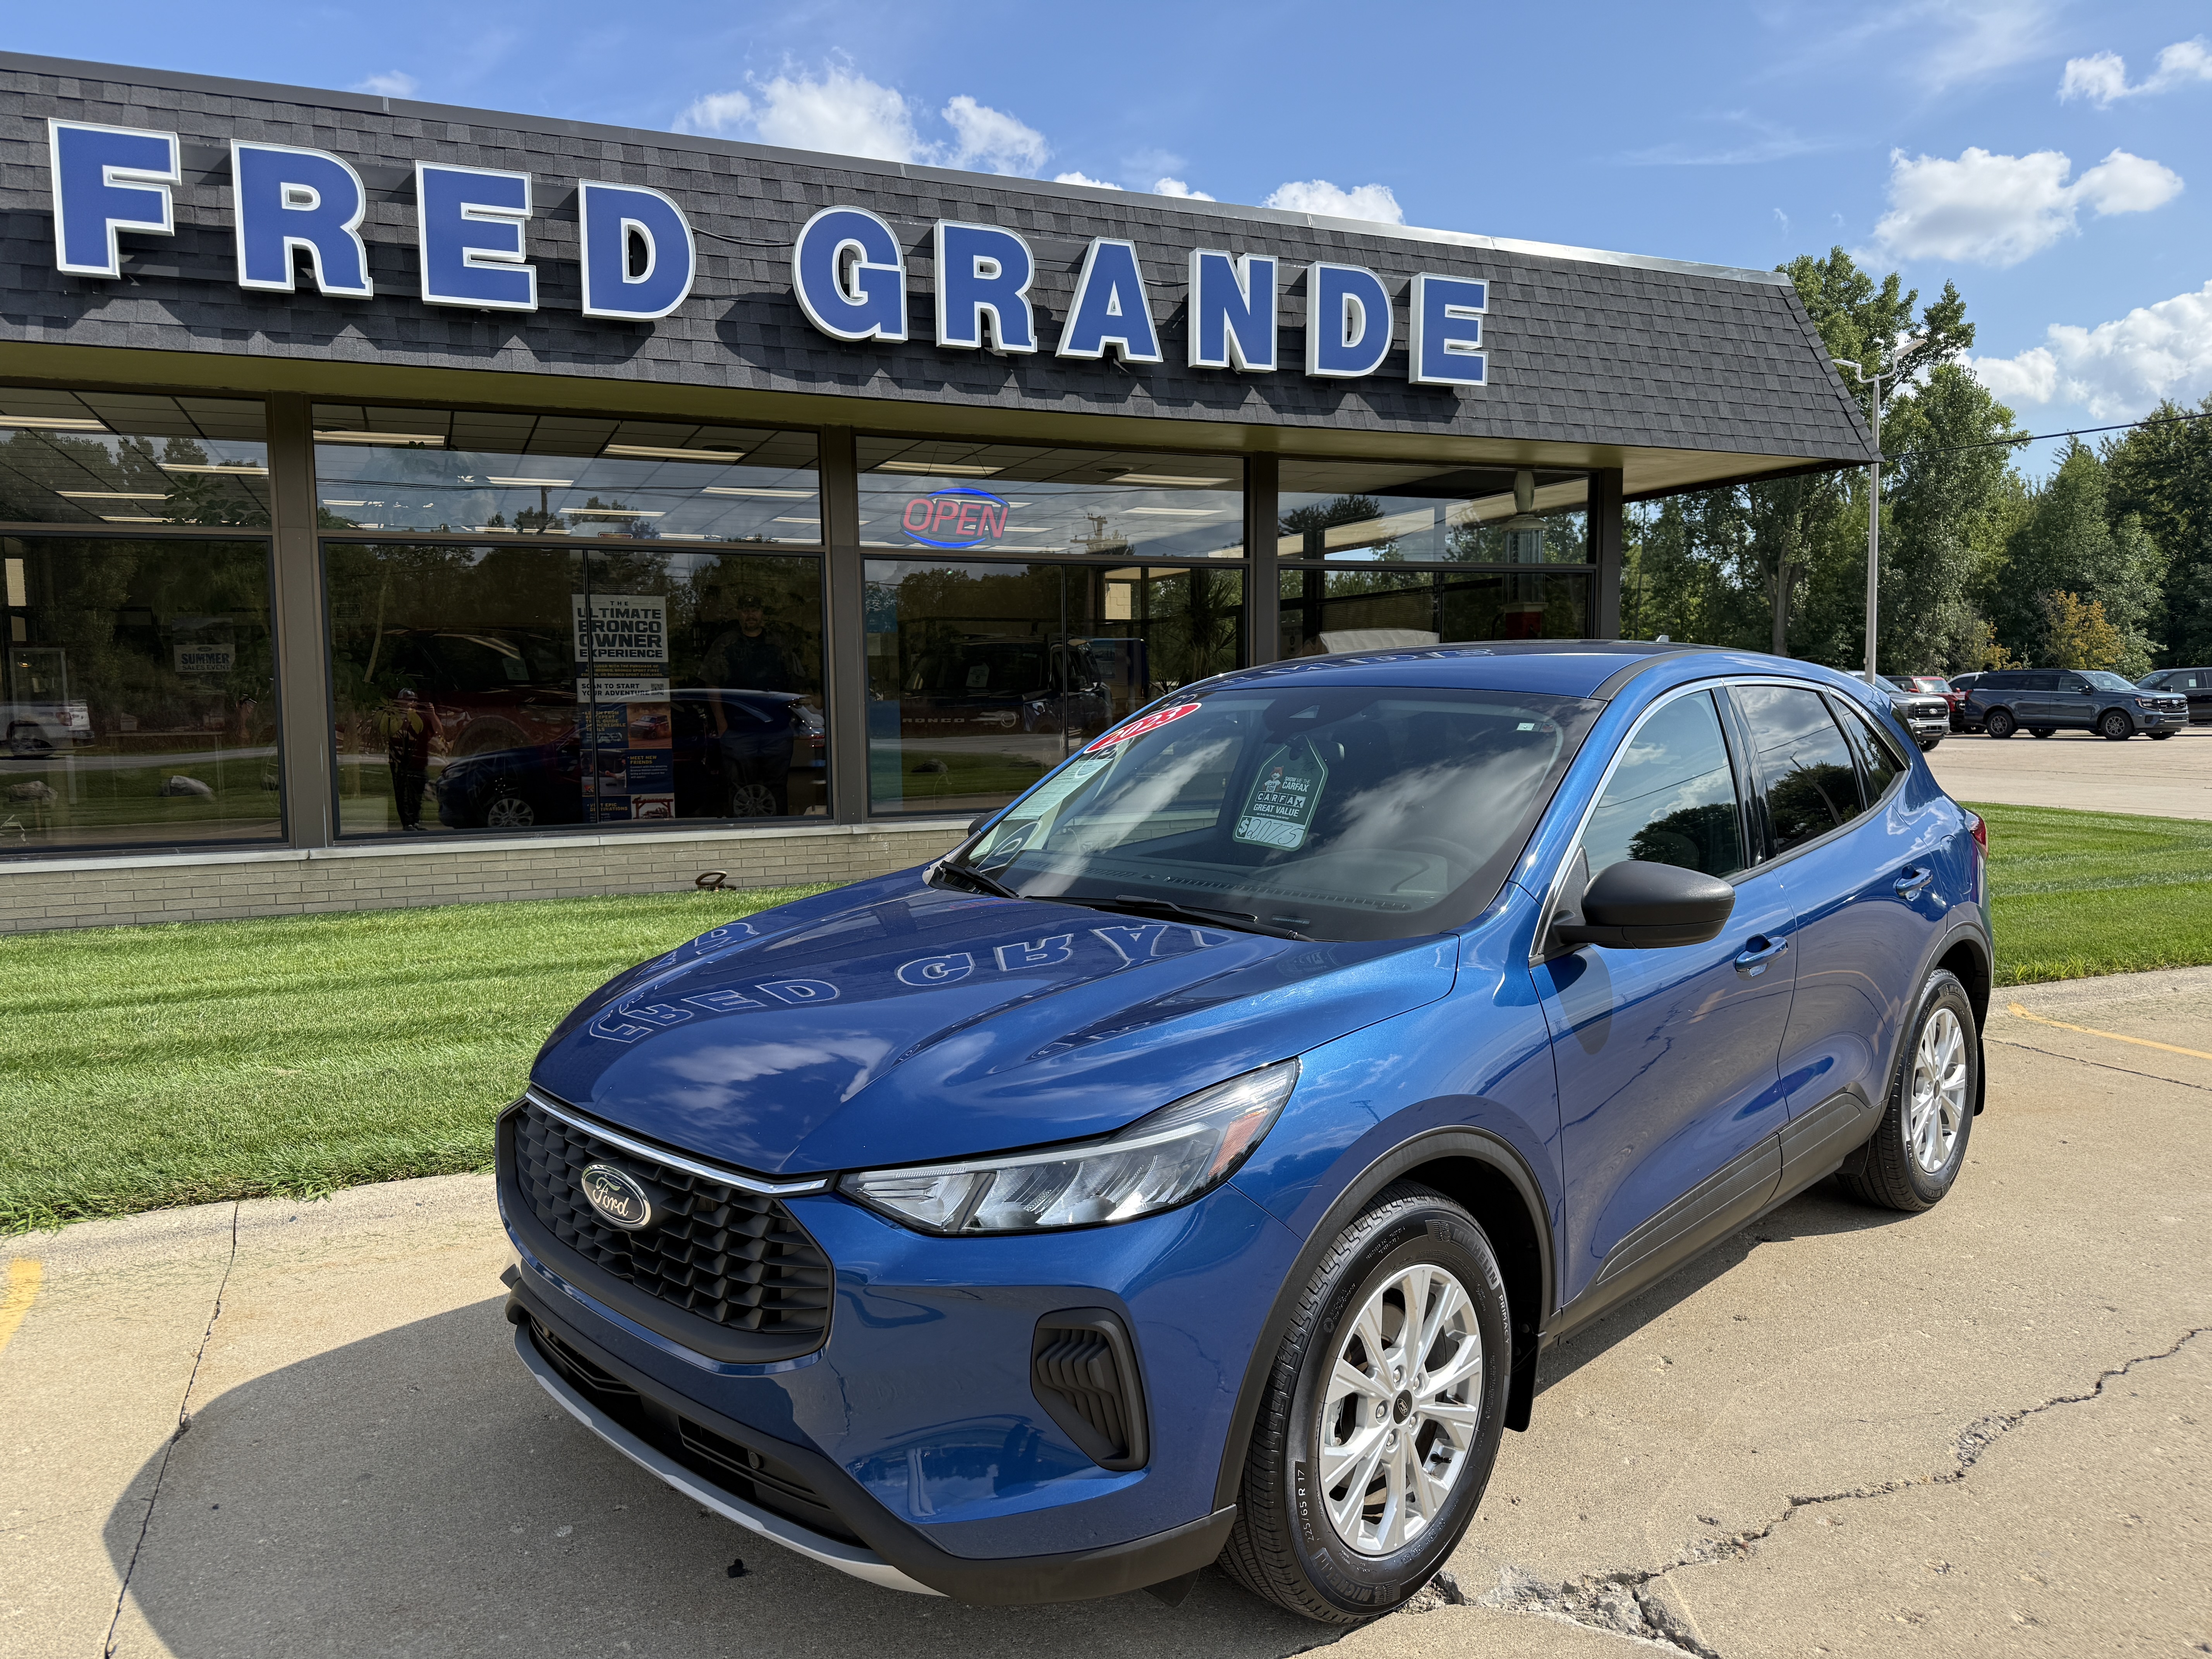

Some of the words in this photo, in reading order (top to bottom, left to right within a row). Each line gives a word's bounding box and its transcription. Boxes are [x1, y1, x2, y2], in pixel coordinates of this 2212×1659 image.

[48, 118, 697, 321] FRED
[792, 205, 1490, 386] GRANDE
[903, 498, 1008, 538] OPEN
[577, 608, 661, 619] ULTIMATE
[578, 620, 662, 633] BRONCO
[579, 634, 662, 648] OWNER
[181, 653, 230, 664] SUMMER
[580, 649, 663, 658] EXPERIENCE
[1099, 707, 1182, 748] 2023
[1282, 781, 1309, 792] CARFAX
[1257, 793, 1304, 808] CARFAX
[1253, 804, 1275, 813] GREAT
[1276, 806, 1300, 817] VALUE
[1238, 818, 1249, 835] $
[1247, 819, 1305, 845] 20775
[592, 1177, 630, 1217] Ford
[1452, 1228, 1498, 1285] MICHELIN
[1498, 1294, 1510, 1345] PRIMACY
[1398, 1401, 1408, 1414] Ford
[1298, 1469, 1305, 1482] 17
[1298, 1488, 1306, 1496] R
[1314, 1553, 1372, 1602] MICHELIN
